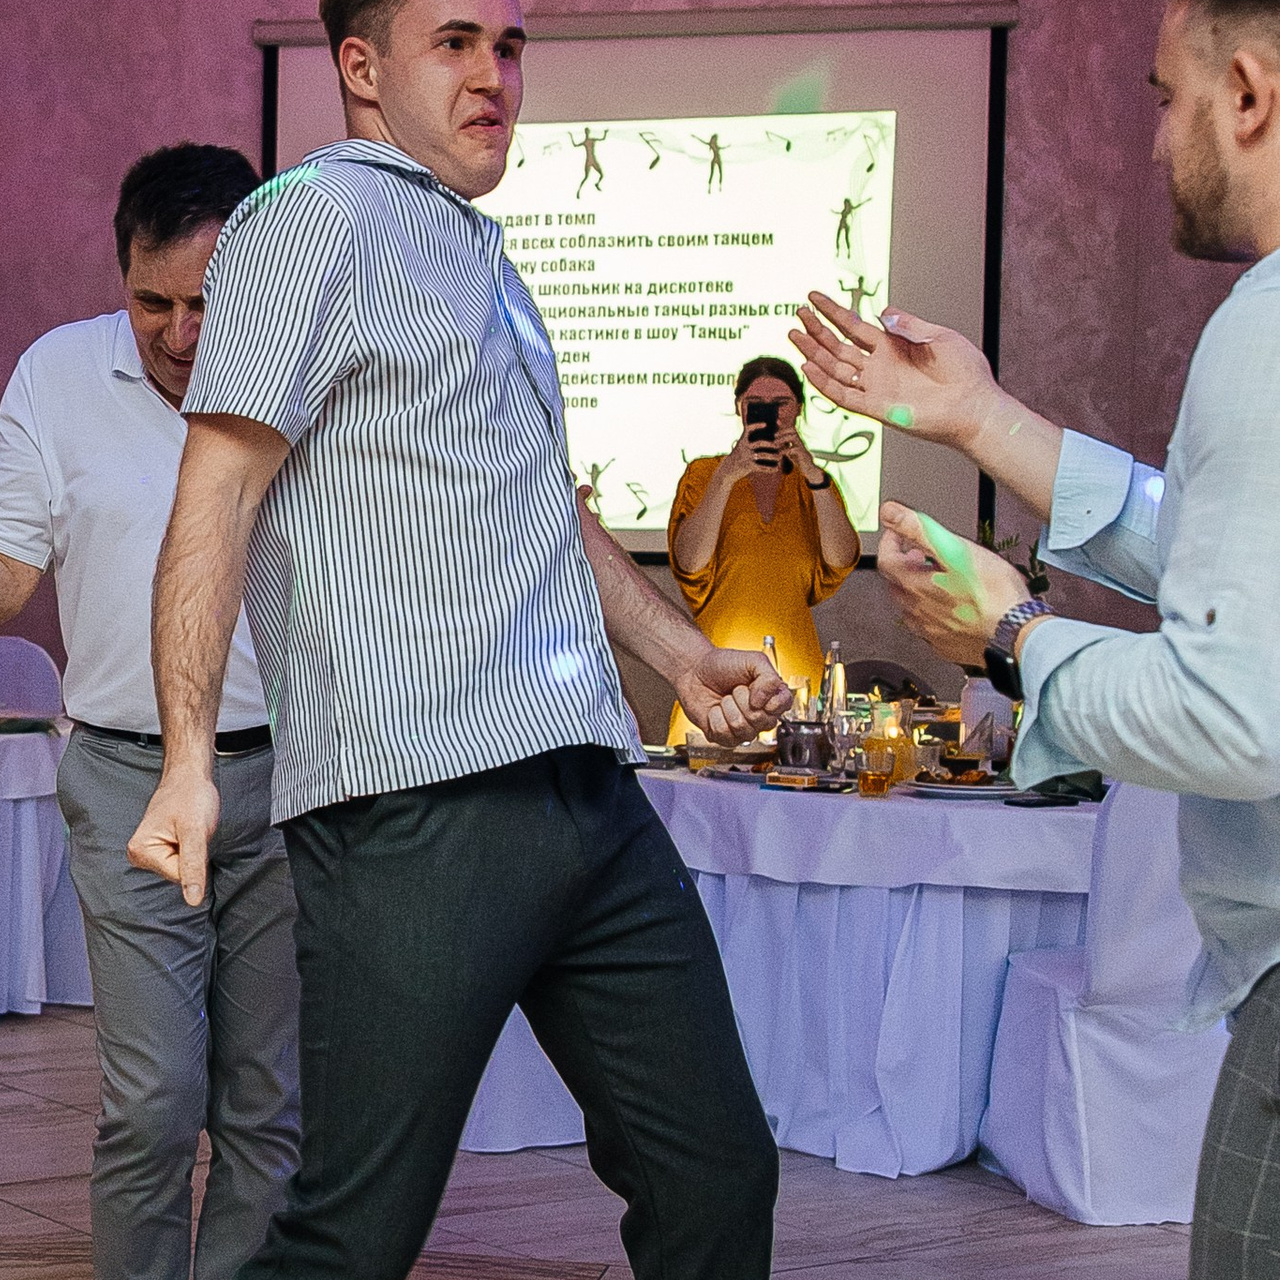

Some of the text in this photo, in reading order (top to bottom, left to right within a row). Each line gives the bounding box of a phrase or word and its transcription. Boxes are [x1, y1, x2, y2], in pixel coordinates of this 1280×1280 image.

[486, 213, 596, 227] адает в темп
[522, 237, 555, 250] всех
[560, 233, 653, 249] соблазнить
[658, 234, 709, 247] своим
[713, 232, 774, 248] танцем
[541, 258, 596, 273] собака
[538, 283, 620, 296] школьник
[624, 282, 643, 295] на
[647, 280, 734, 296] дискотеке
[654, 303, 705, 318] танцы
[709, 303, 769, 318] разных
[560, 328, 630, 341] кастинге
[634, 328, 642, 340] в
[647, 327, 678, 341] шоу
[683, 324, 750, 342] "Танцы"
[561, 370, 648, 387] действием
